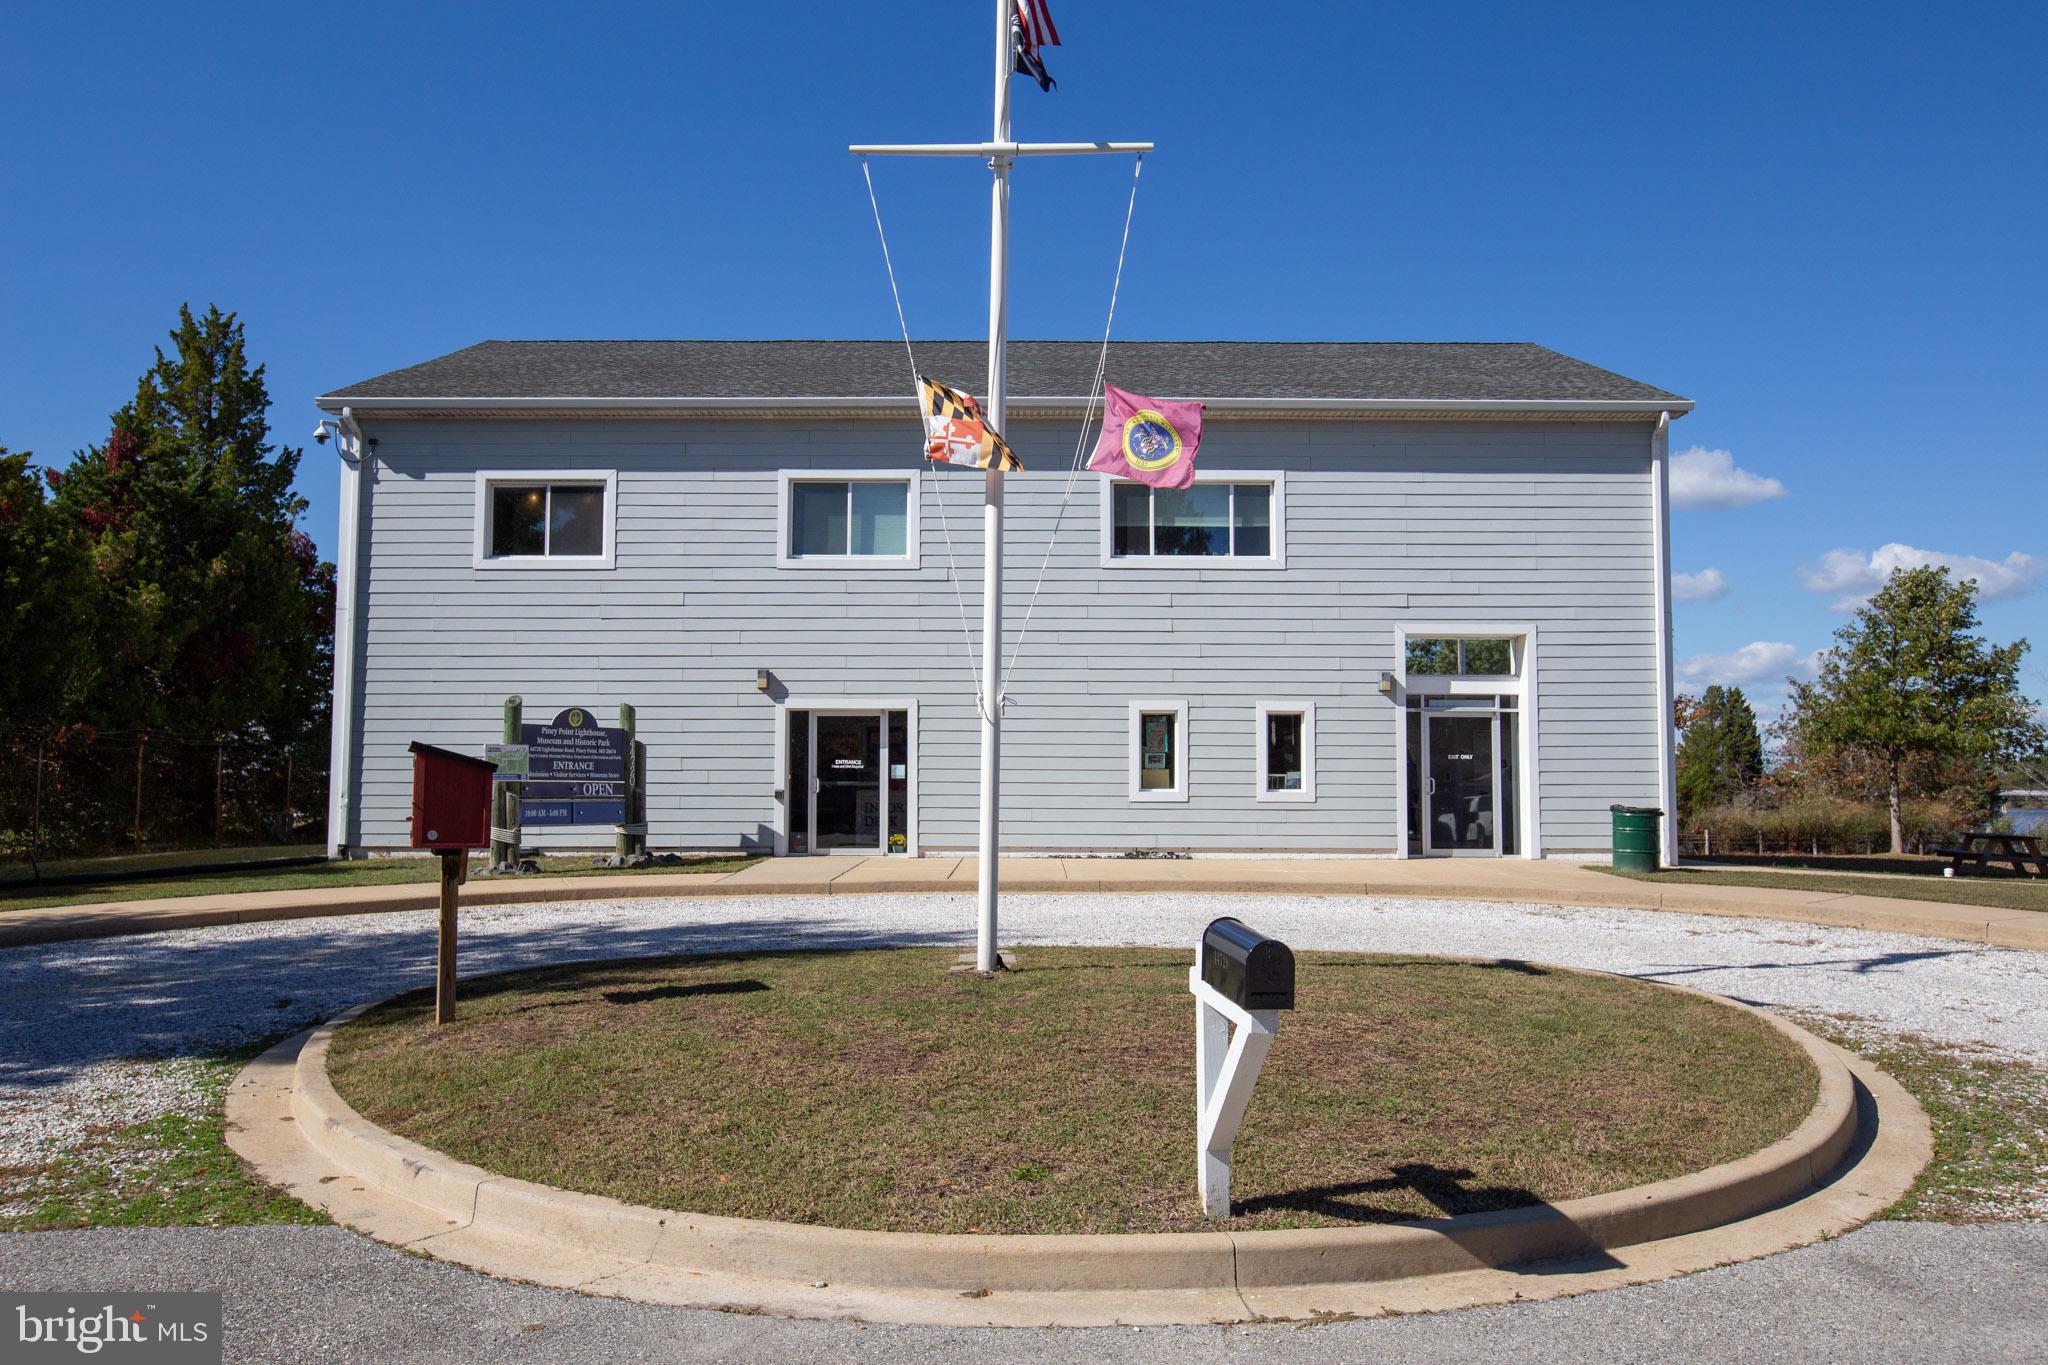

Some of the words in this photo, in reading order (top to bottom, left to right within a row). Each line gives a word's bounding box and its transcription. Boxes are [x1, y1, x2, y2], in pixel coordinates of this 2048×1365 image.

[541, 727, 557, 736] Piney
[558, 728, 574, 736] Point
[537, 737, 562, 745] Museum
[563, 737, 574, 745] and
[575, 738, 597, 746] Historic
[598, 738, 611, 746] Park
[553, 760, 595, 770] ENTRANCE
[583, 782, 614, 796] OPEN
[559, 808, 568, 817] PM
